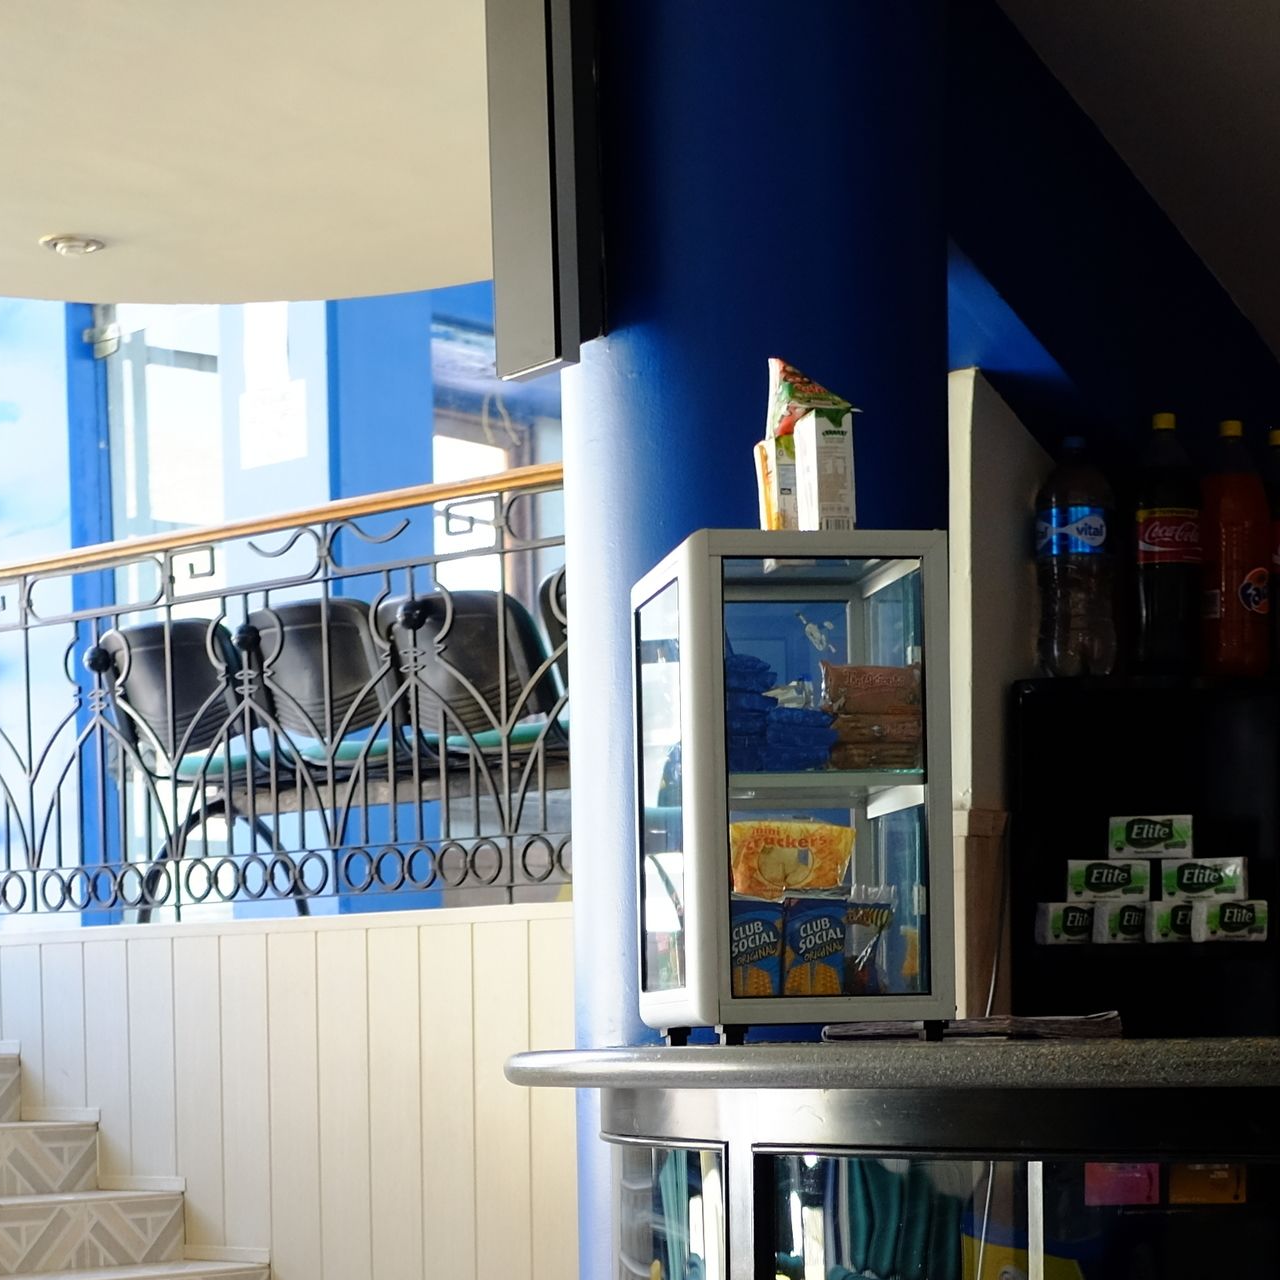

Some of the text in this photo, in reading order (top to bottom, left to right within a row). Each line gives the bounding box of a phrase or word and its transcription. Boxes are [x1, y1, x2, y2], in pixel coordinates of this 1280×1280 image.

[1076, 523, 1104, 536] vital
[751, 827, 781, 836] mini
[1130, 823, 1170, 839] Elite
[745, 835, 828, 850] crackers
[1090, 869, 1129, 884] Elite
[1182, 868, 1220, 884] Elite
[1066, 911, 1089, 927] Elit
[1223, 908, 1254, 923] Elite
[732, 920, 764, 942] CLUB
[800, 916, 831, 938] CLUB
[731, 930, 778, 957] SOCIAL
[798, 926, 844, 955] SOCIAL
[736, 944, 778, 966] ORIGINAL
[803, 940, 844, 962] ORIGINAL
